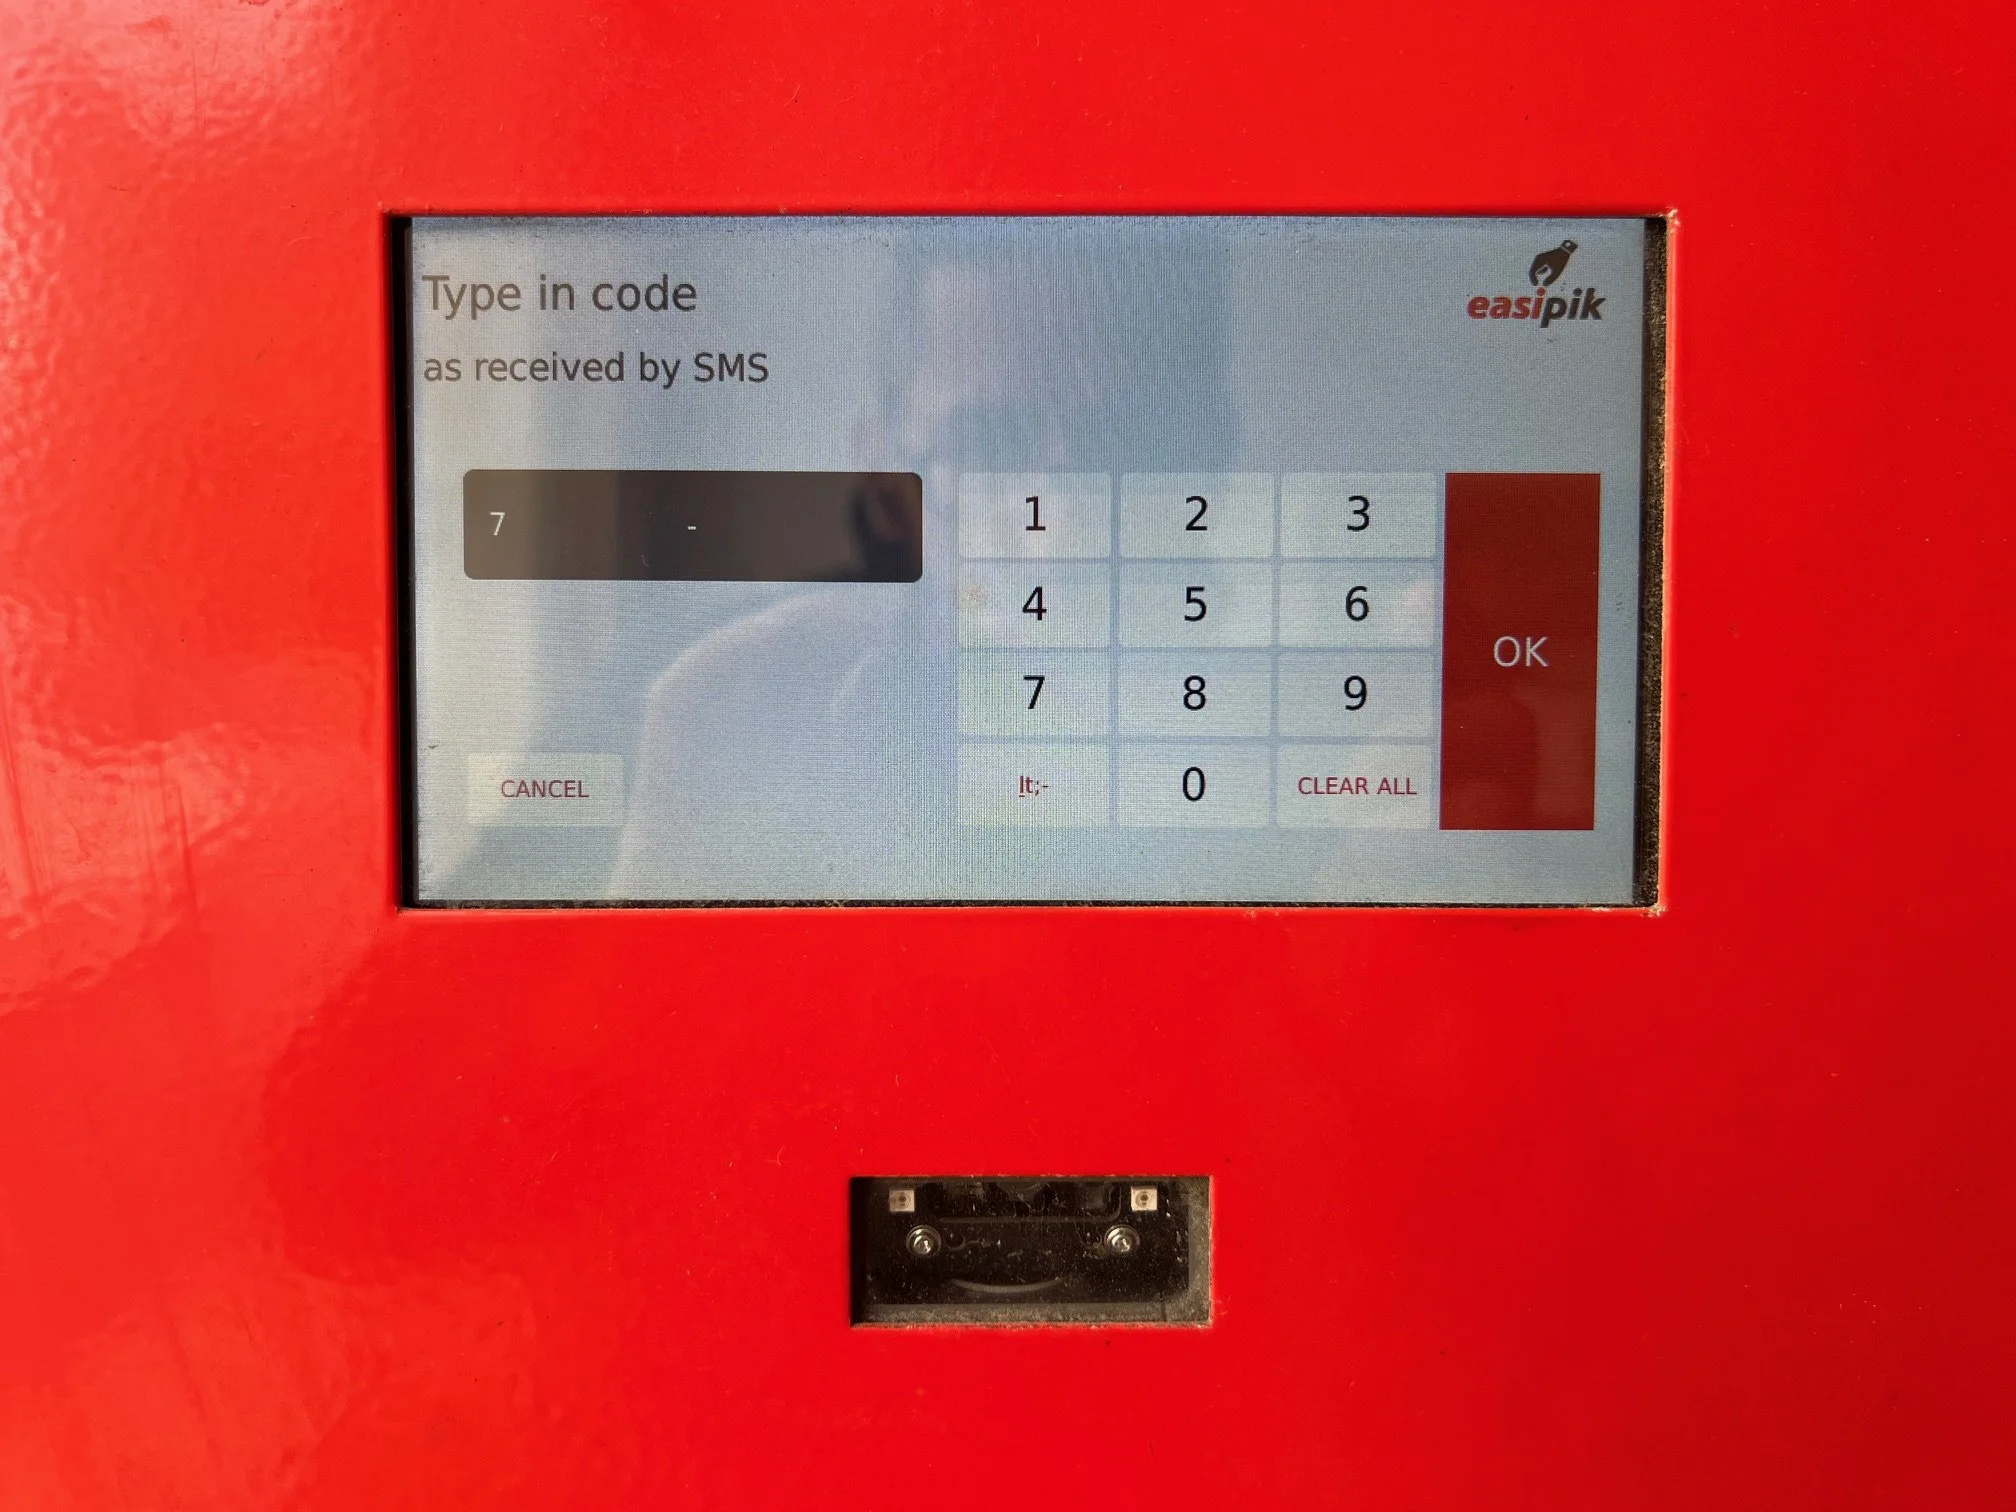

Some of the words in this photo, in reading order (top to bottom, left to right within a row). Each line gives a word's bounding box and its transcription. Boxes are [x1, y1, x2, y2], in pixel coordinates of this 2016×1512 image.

[422, 275, 522, 320] Type
[538, 274, 575, 311] in
[591, 274, 698, 312] code
[1466, 287, 1606, 329] easipik
[423, 355, 462, 382] as
[474, 352, 625, 382] received
[638, 352, 681, 388] by
[693, 352, 770, 383] SMS
[490, 512, 506, 536] 7
[1024, 496, 1047, 532] 1
[1184, 496, 1208, 532] 2
[1346, 496, 1371, 531] 3
[1022, 586, 1048, 622] 4
[1184, 586, 1208, 622] 5
[1344, 586, 1370, 622] 6
[1493, 636, 1549, 669] OK
[1023, 676, 1046, 711] 7
[1182, 676, 1207, 711] 8
[1343, 675, 1368, 711] 9
[499, 778, 590, 799] CANCEL
[1181, 767, 1206, 803] 0
[1297, 777, 1370, 796] CLEAR
[1377, 777, 1417, 796] ALL
